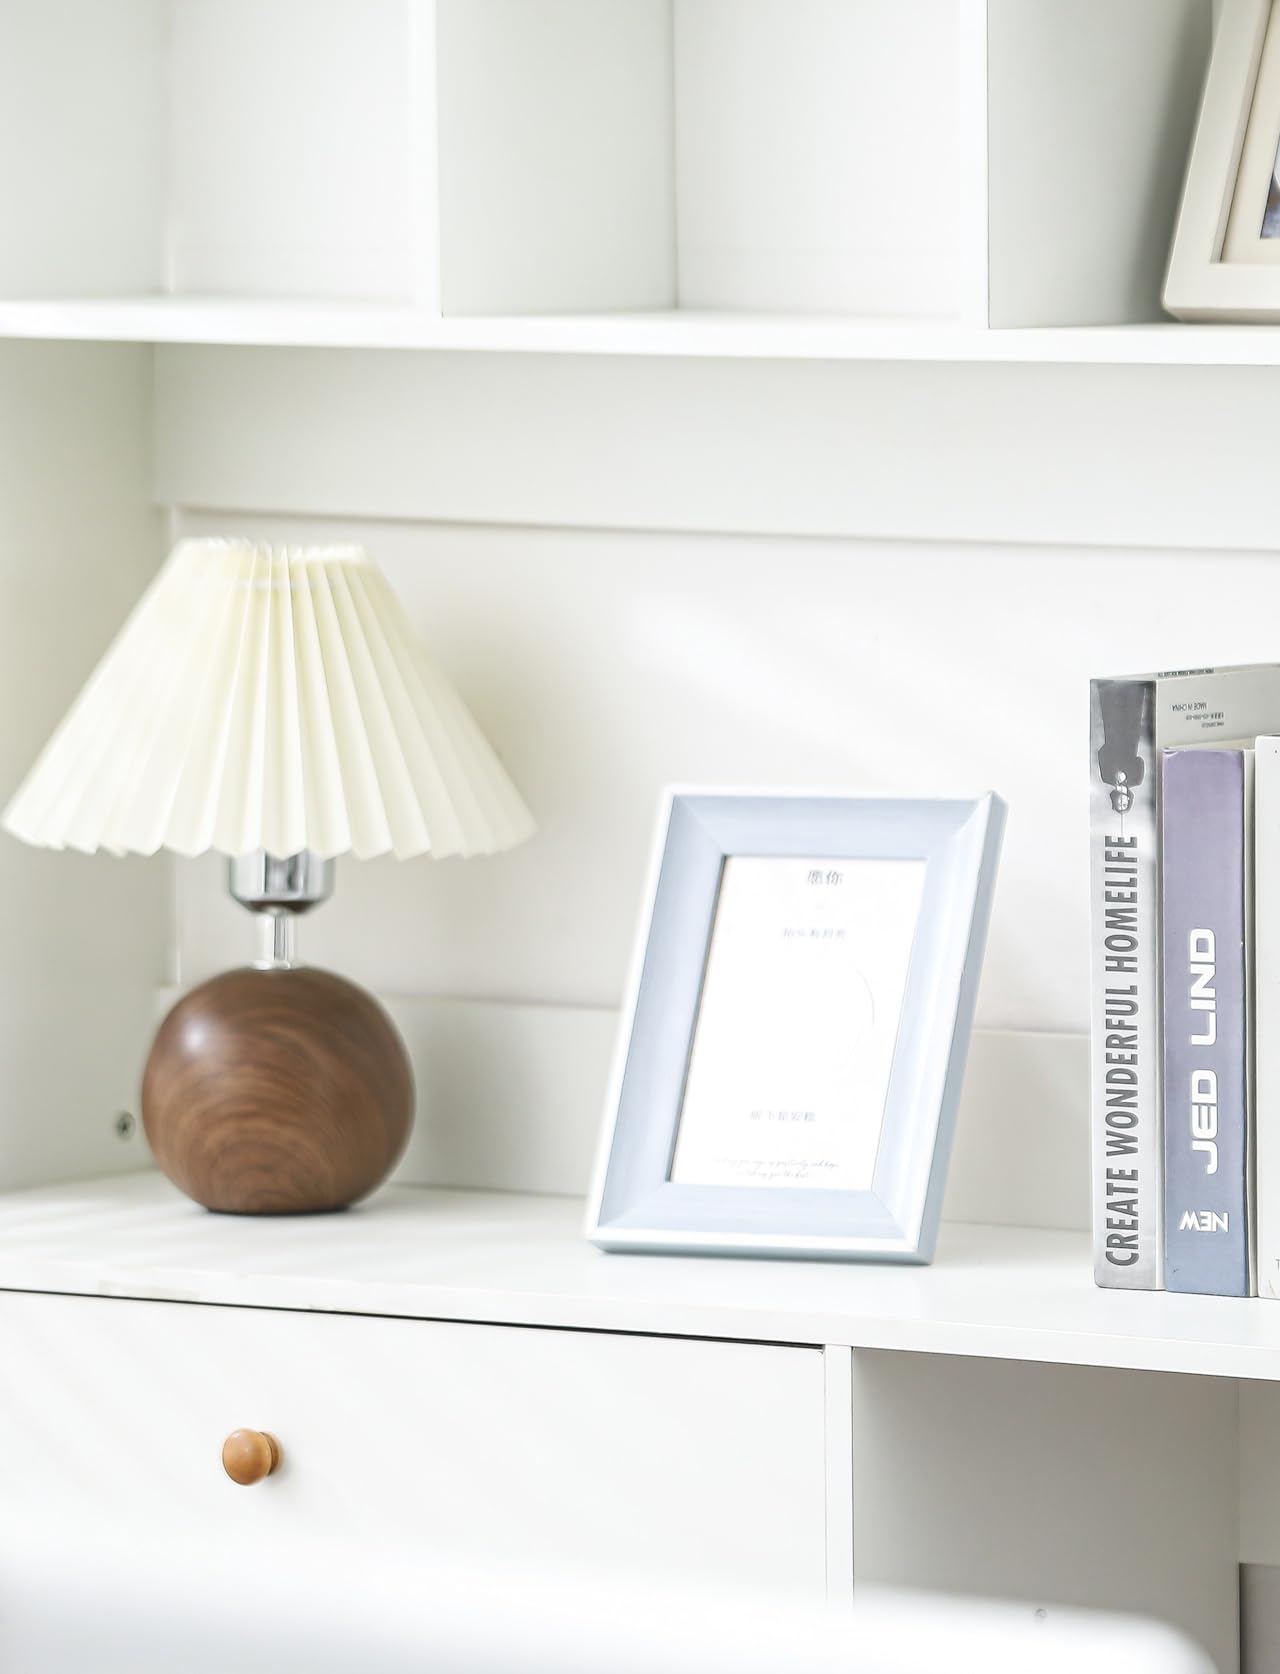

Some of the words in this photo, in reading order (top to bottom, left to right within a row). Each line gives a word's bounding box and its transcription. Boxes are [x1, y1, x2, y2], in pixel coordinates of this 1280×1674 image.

[1172, 703, 1187, 712] CHINA
[1194, 702, 1207, 710] MADE
[1104, 835, 1138, 972] HOMELIFE
[1189, 927, 1218, 1047] LIND
[1105, 984, 1139, 1158] WONDERFUL
[1191, 1069, 1219, 1176] JED
[1105, 1167, 1139, 1266] CREATE
